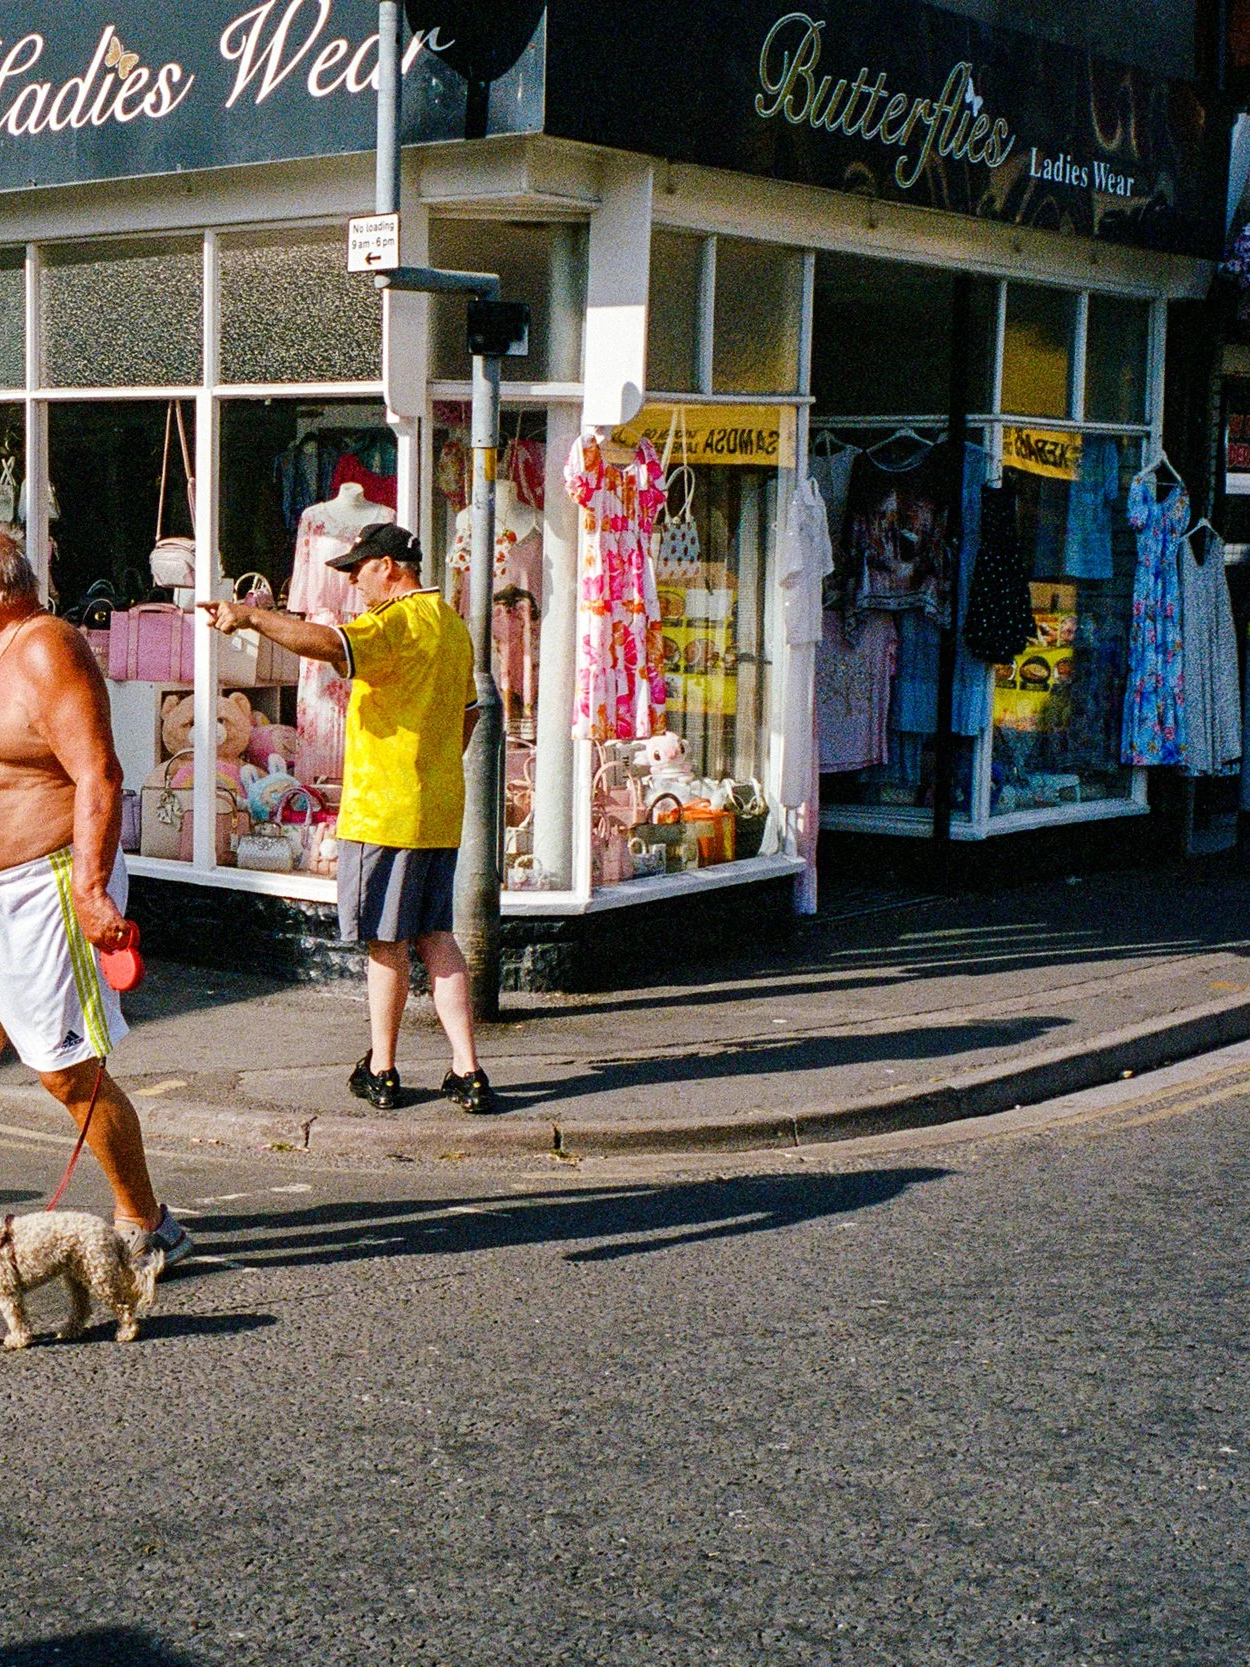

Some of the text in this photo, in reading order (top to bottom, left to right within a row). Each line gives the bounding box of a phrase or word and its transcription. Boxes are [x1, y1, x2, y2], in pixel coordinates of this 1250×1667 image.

[755, 12, 1016, 189] Butterflies
[1029, 146, 1135, 197] Ladies Wear
[353, 221, 394, 233] No loading
